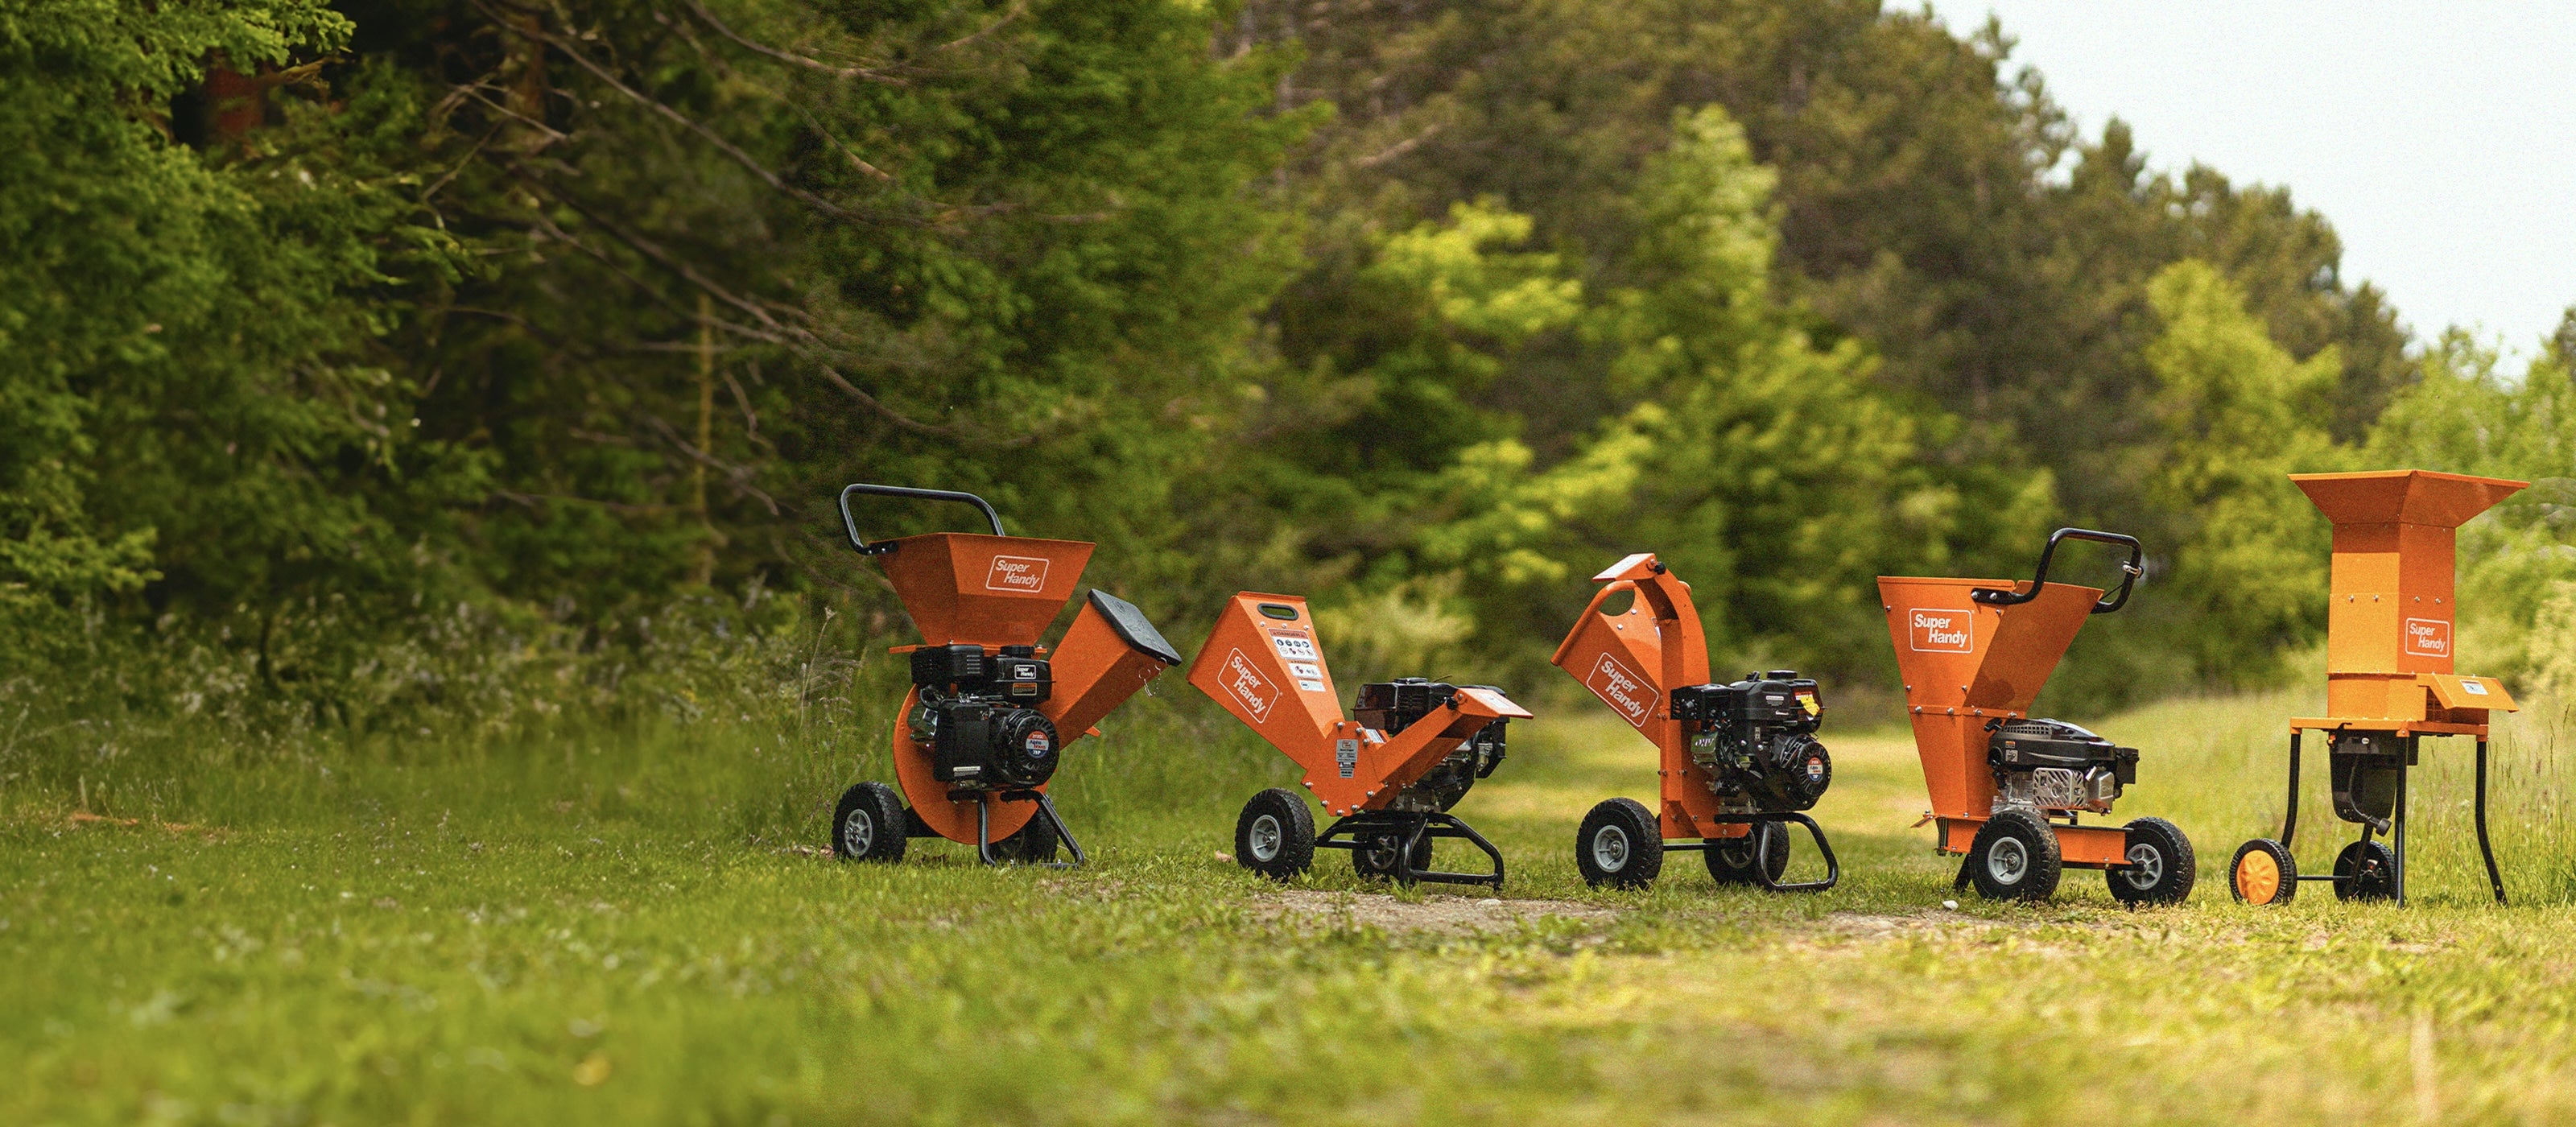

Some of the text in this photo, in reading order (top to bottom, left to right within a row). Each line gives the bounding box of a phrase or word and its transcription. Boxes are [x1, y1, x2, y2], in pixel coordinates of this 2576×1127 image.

[996, 559, 1030, 573] Super
[1003, 572, 1041, 588] Handy
[1913, 613, 1951, 629] Super
[2409, 623, 2436, 636] Super
[1928, 629, 1967, 648] Handy
[2417, 636, 2446, 652] Handy
[1231, 656, 1261, 688] Super
[1601, 661, 1638, 692] Super
[1233, 679, 1266, 714] Handy
[1605, 683, 1645, 717] Handy
